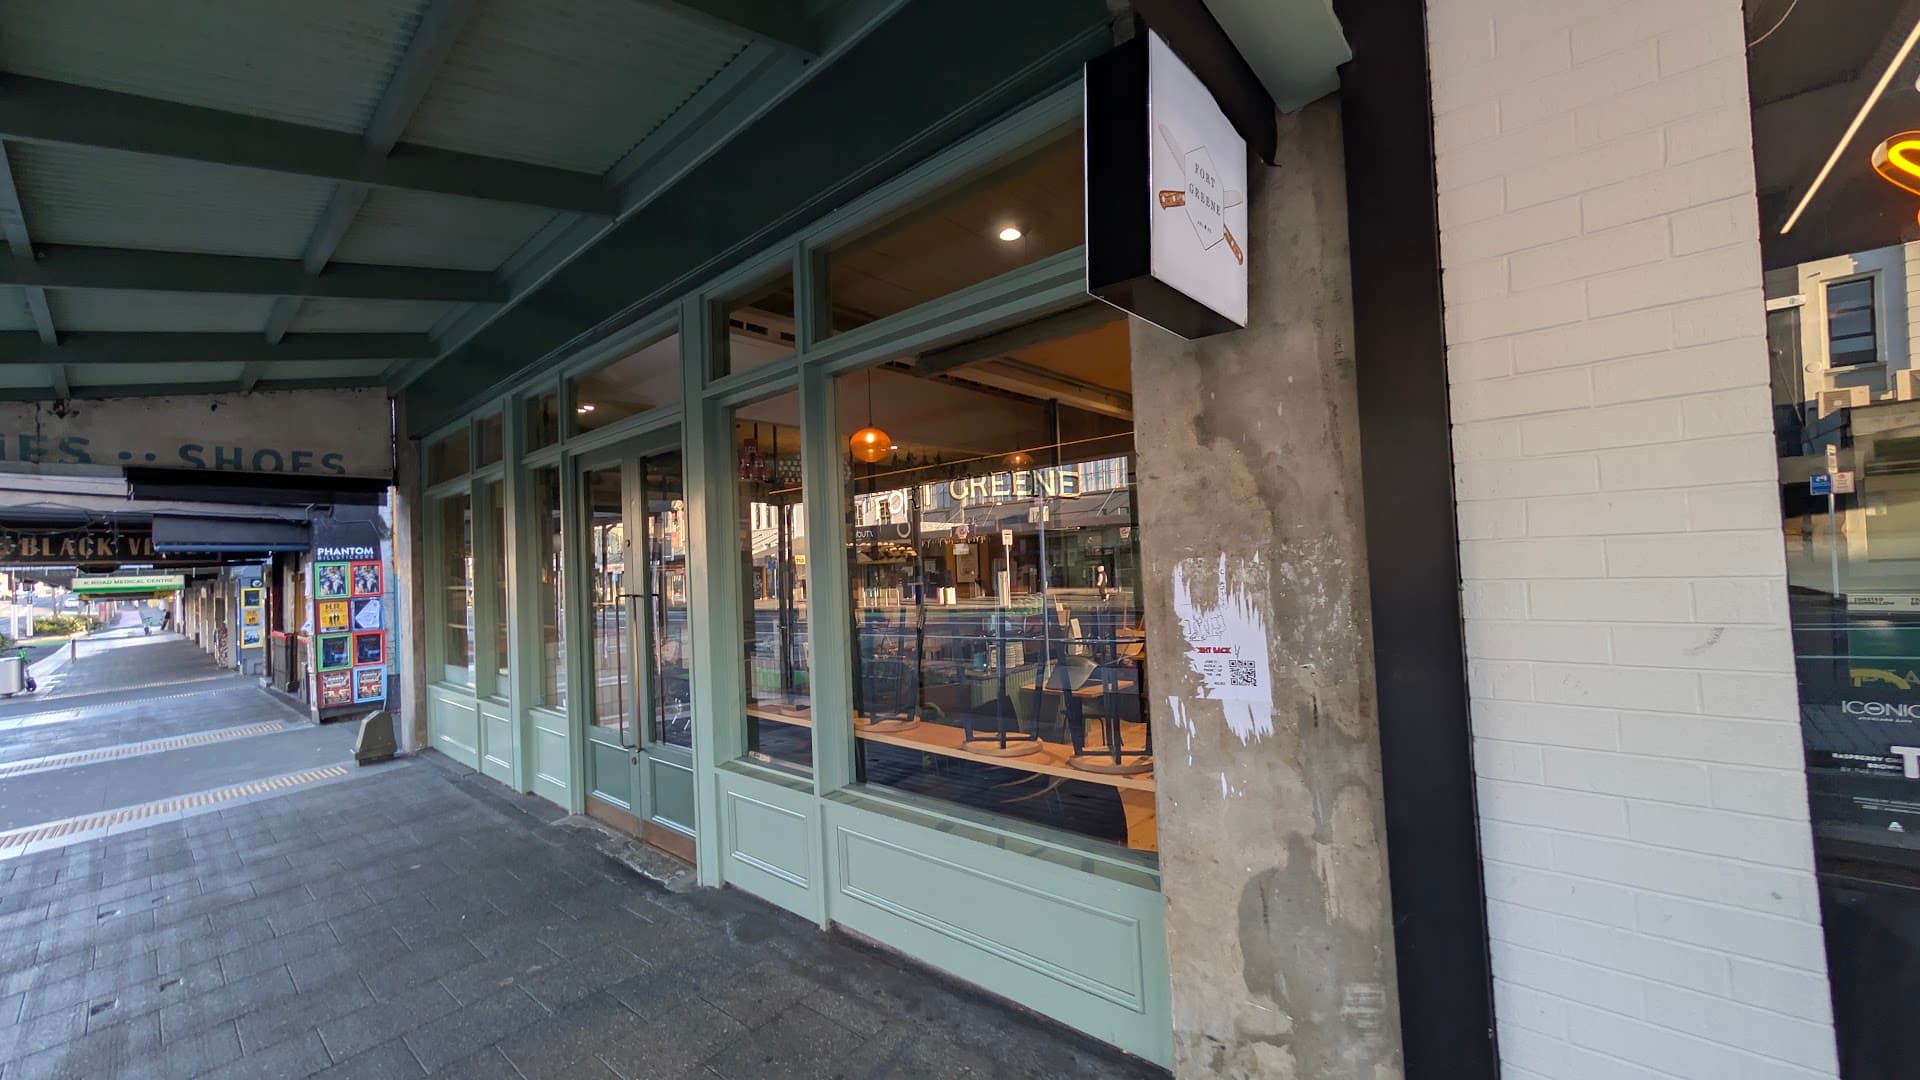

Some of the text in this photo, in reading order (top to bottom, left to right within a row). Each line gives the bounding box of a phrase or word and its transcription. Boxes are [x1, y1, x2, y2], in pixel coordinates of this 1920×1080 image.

[1195, 162, 1215, 188] FORT
[1189, 183, 1221, 217] GREENE
[178, 444, 347, 475] SHOES
[949, 470, 1081, 500] GREENE
[21, 537, 113, 557] BLACK
[317, 546, 374, 556] PHANTOM
